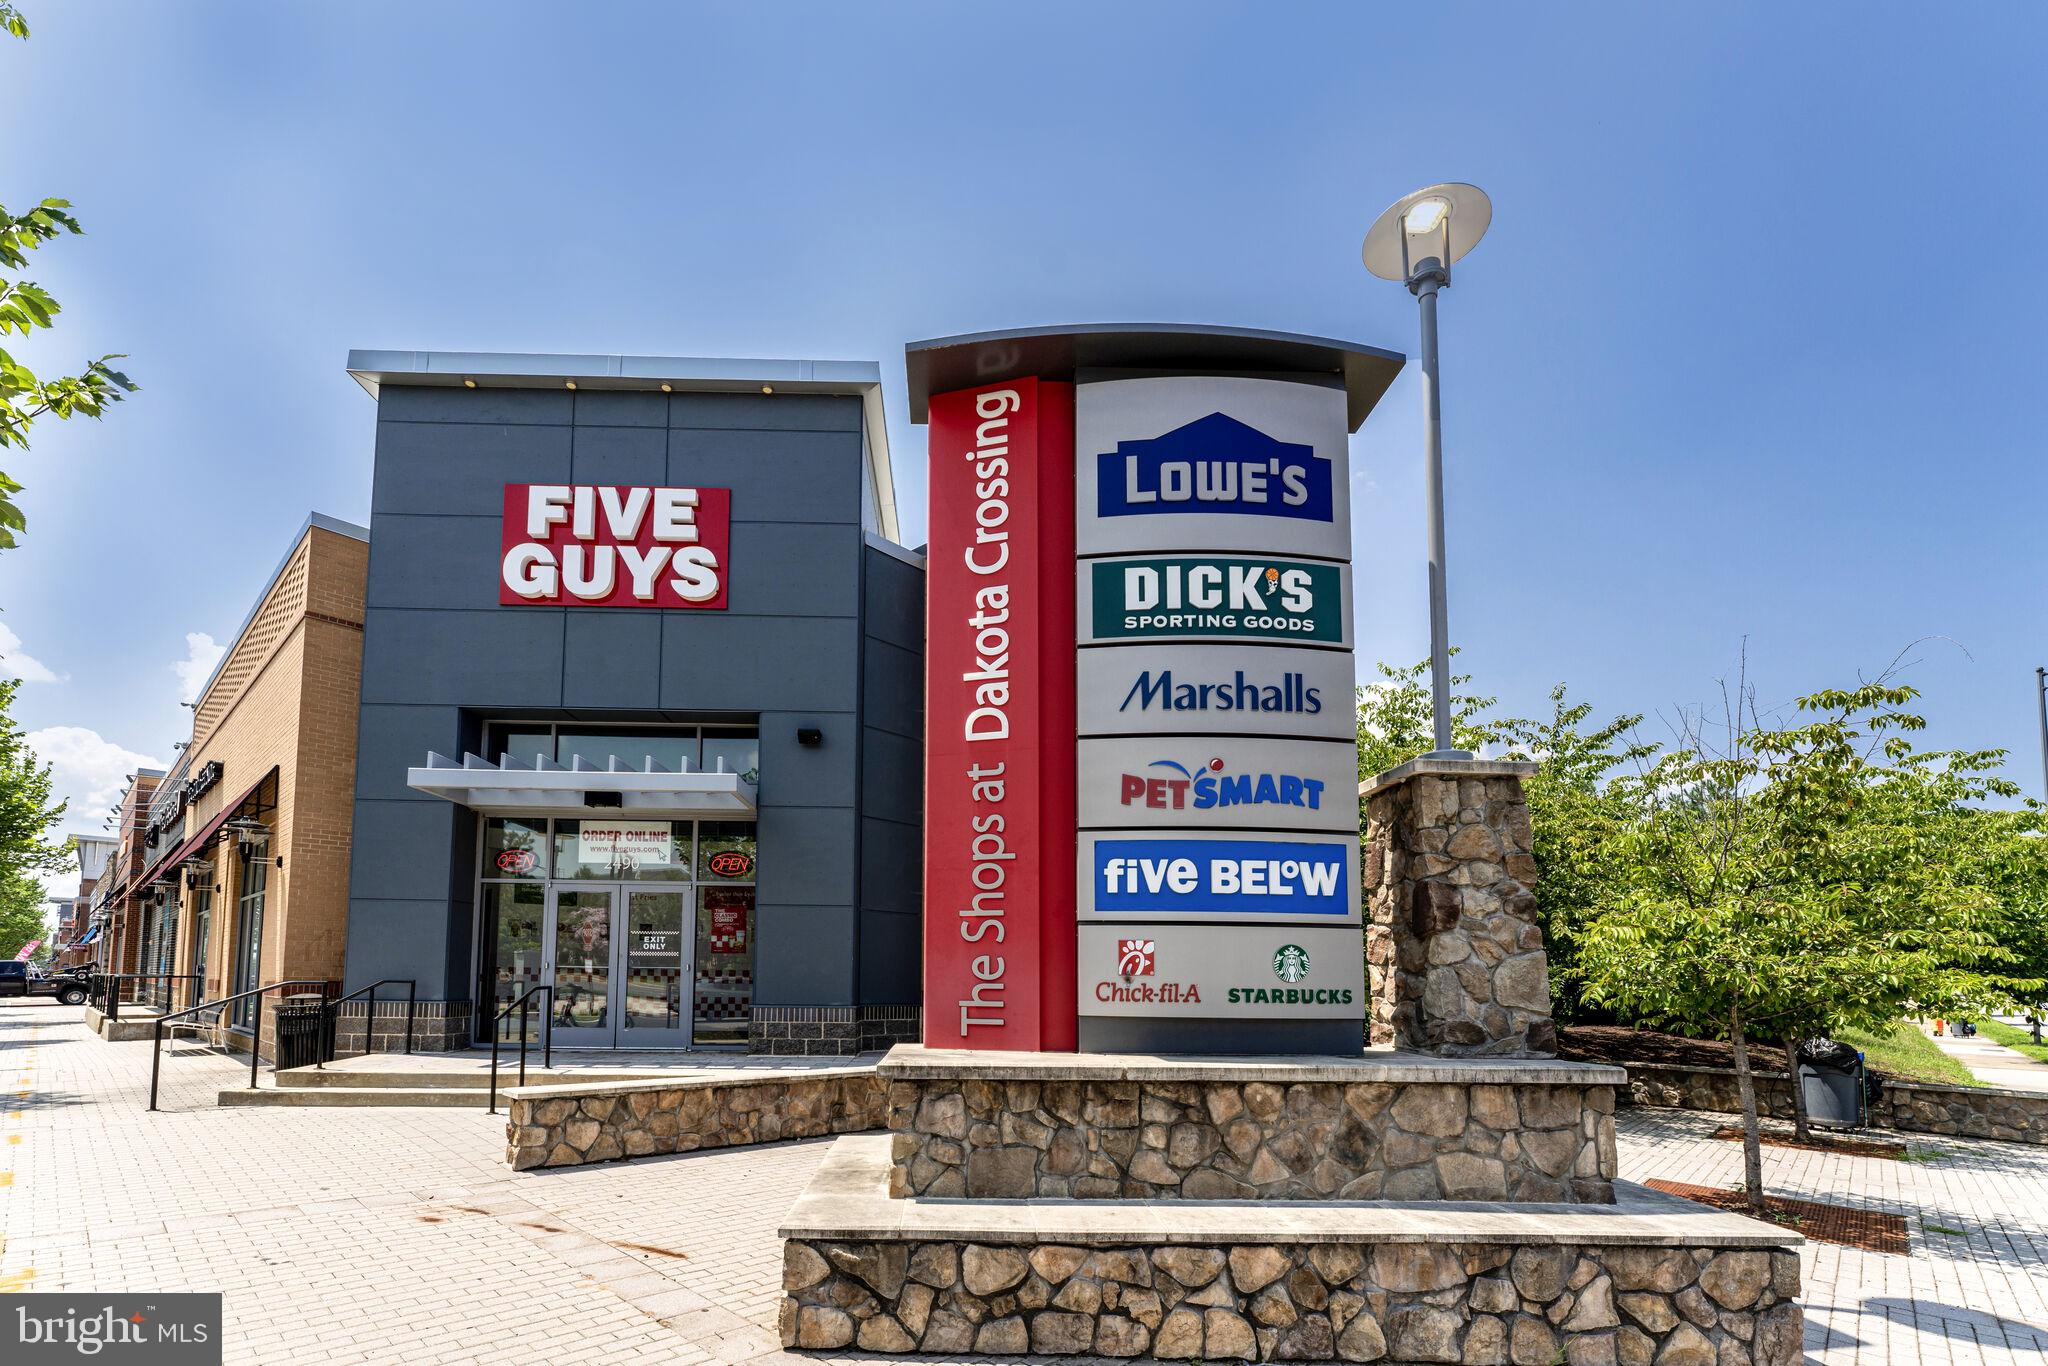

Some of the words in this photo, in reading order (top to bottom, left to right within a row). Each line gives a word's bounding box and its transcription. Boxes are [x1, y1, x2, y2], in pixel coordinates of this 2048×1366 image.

[965, 389, 1021, 575] Crossing
[1125, 455, 1308, 506] LOWE'S
[527, 485, 699, 542] FIVE
[502, 542, 720, 602] GUYS
[1124, 565, 1313, 613] DICK'S
[1124, 614, 1237, 629] SPORTING
[1243, 615, 1315, 632] GOODS
[963, 584, 1010, 742] Dakota
[1119, 670, 1321, 714] Marshalls
[966, 761, 1006, 802] at
[582, 829, 622, 841] ORDER
[625, 830, 668, 842] ONLINE
[497, 854, 536, 867] OPEN
[604, 856, 640, 870] 2490
[711, 857, 749, 871] OPEN
[959, 813, 1016, 943] Shops
[1103, 858, 1199, 894] five
[959, 955, 1006, 1037] The
[1095, 981, 1201, 1004] Chick-fil-A
[1228, 987, 1352, 1005] STARBUCKS
